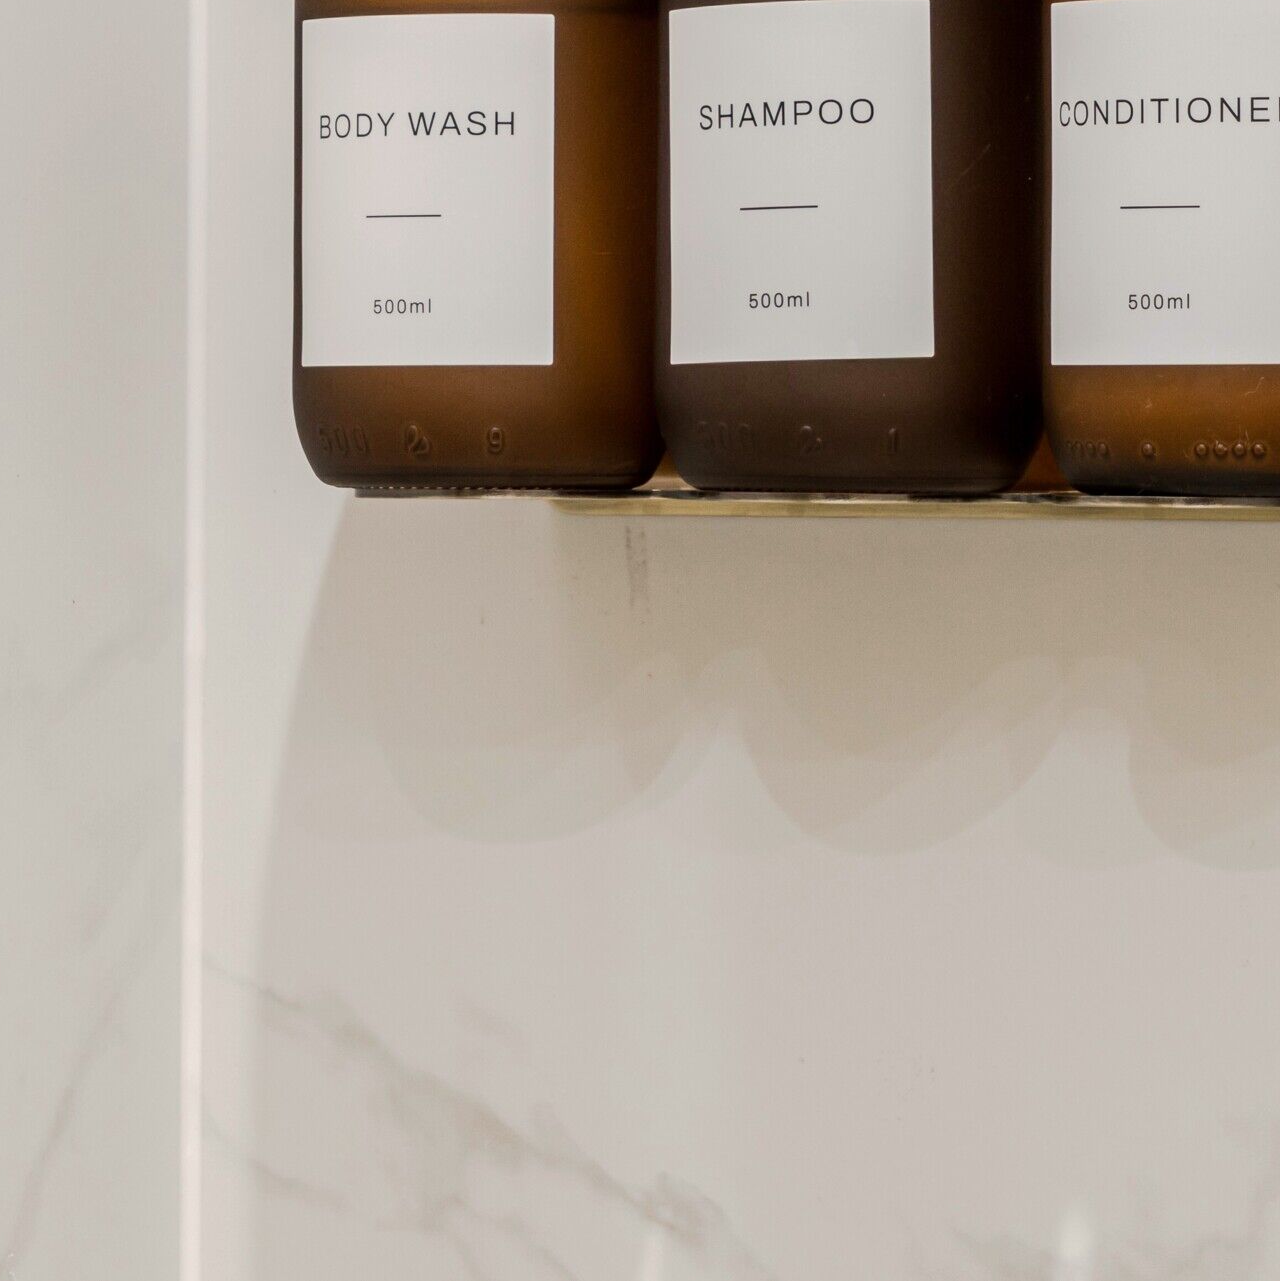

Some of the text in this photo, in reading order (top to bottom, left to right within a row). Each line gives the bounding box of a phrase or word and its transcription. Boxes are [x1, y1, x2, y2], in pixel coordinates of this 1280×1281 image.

[318, 109, 517, 140] BODY WASH
[698, 97, 877, 132] SHAMPOO
[372, 297, 433, 315] 500ml
[748, 290, 812, 310] 500ml
[1127, 292, 1192, 311] 500ml
